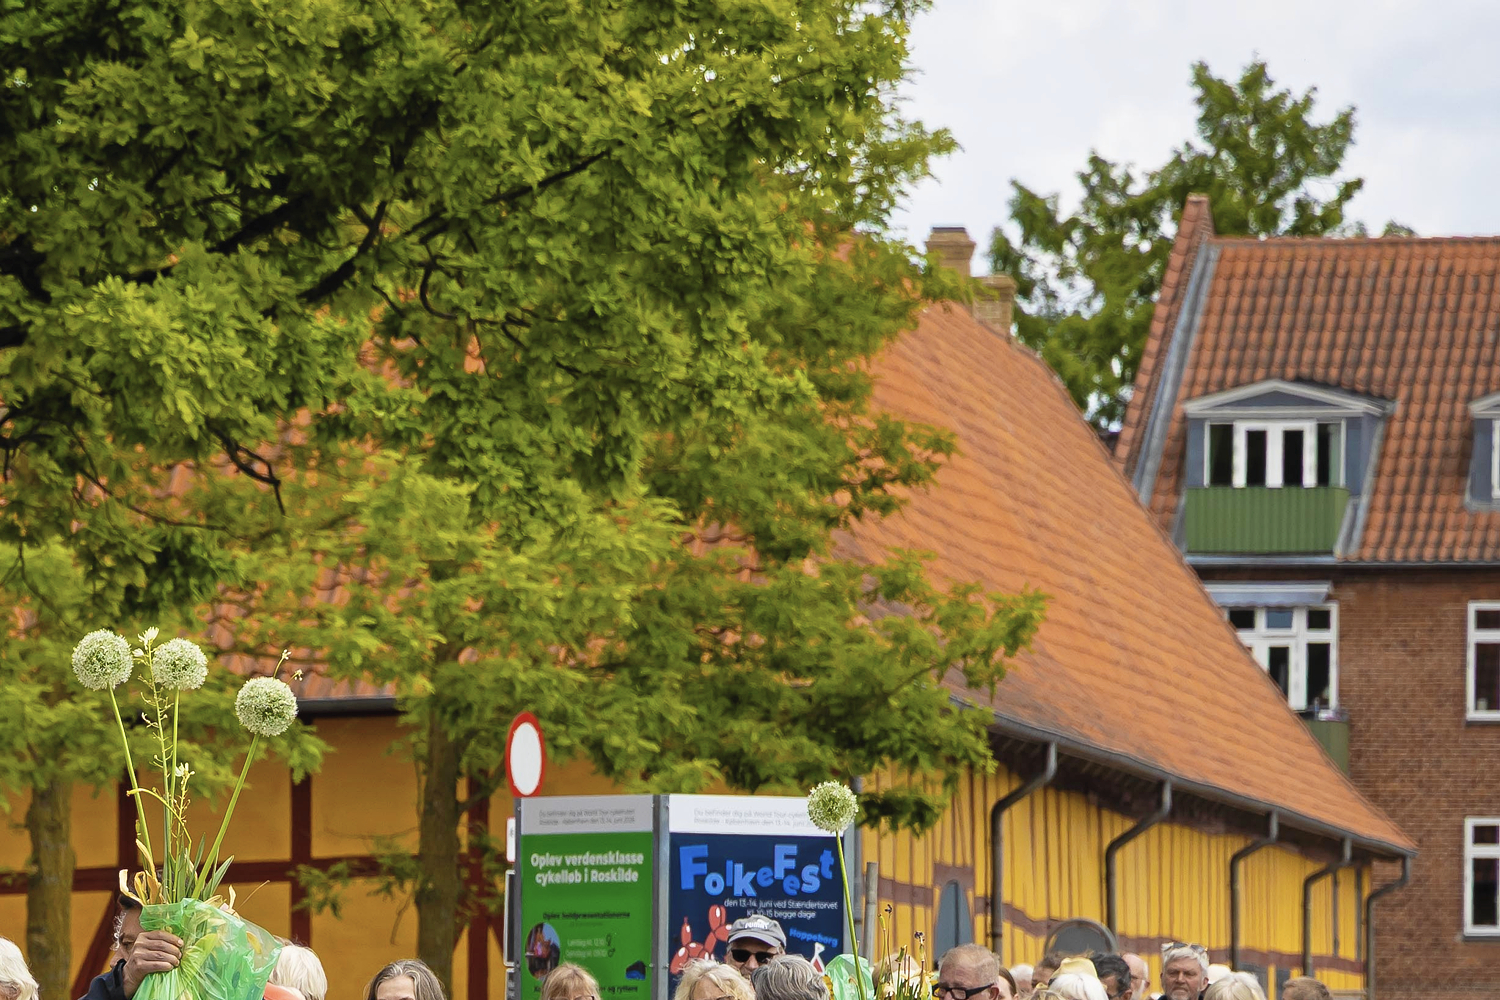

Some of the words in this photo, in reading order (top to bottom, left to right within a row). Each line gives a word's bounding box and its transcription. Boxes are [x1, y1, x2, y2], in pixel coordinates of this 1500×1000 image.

[531, 853, 562, 870] Oplev
[564, 850, 644, 867] verdensklasse
[535, 869, 582, 887] cykelløb
[584, 867, 588, 883] i
[590, 867, 639, 883] Roskilde
[679, 843, 835, 898] FolkeFest
[724, 898, 738, 908] den
[758, 899, 773, 910] juni
[773, 899, 787, 908] ved
[787, 899, 838, 911] Stændertorvet
[774, 909, 797, 919] begge
[798, 910, 816, 920] dage
[789, 927, 839, 948] Hoppeborg
